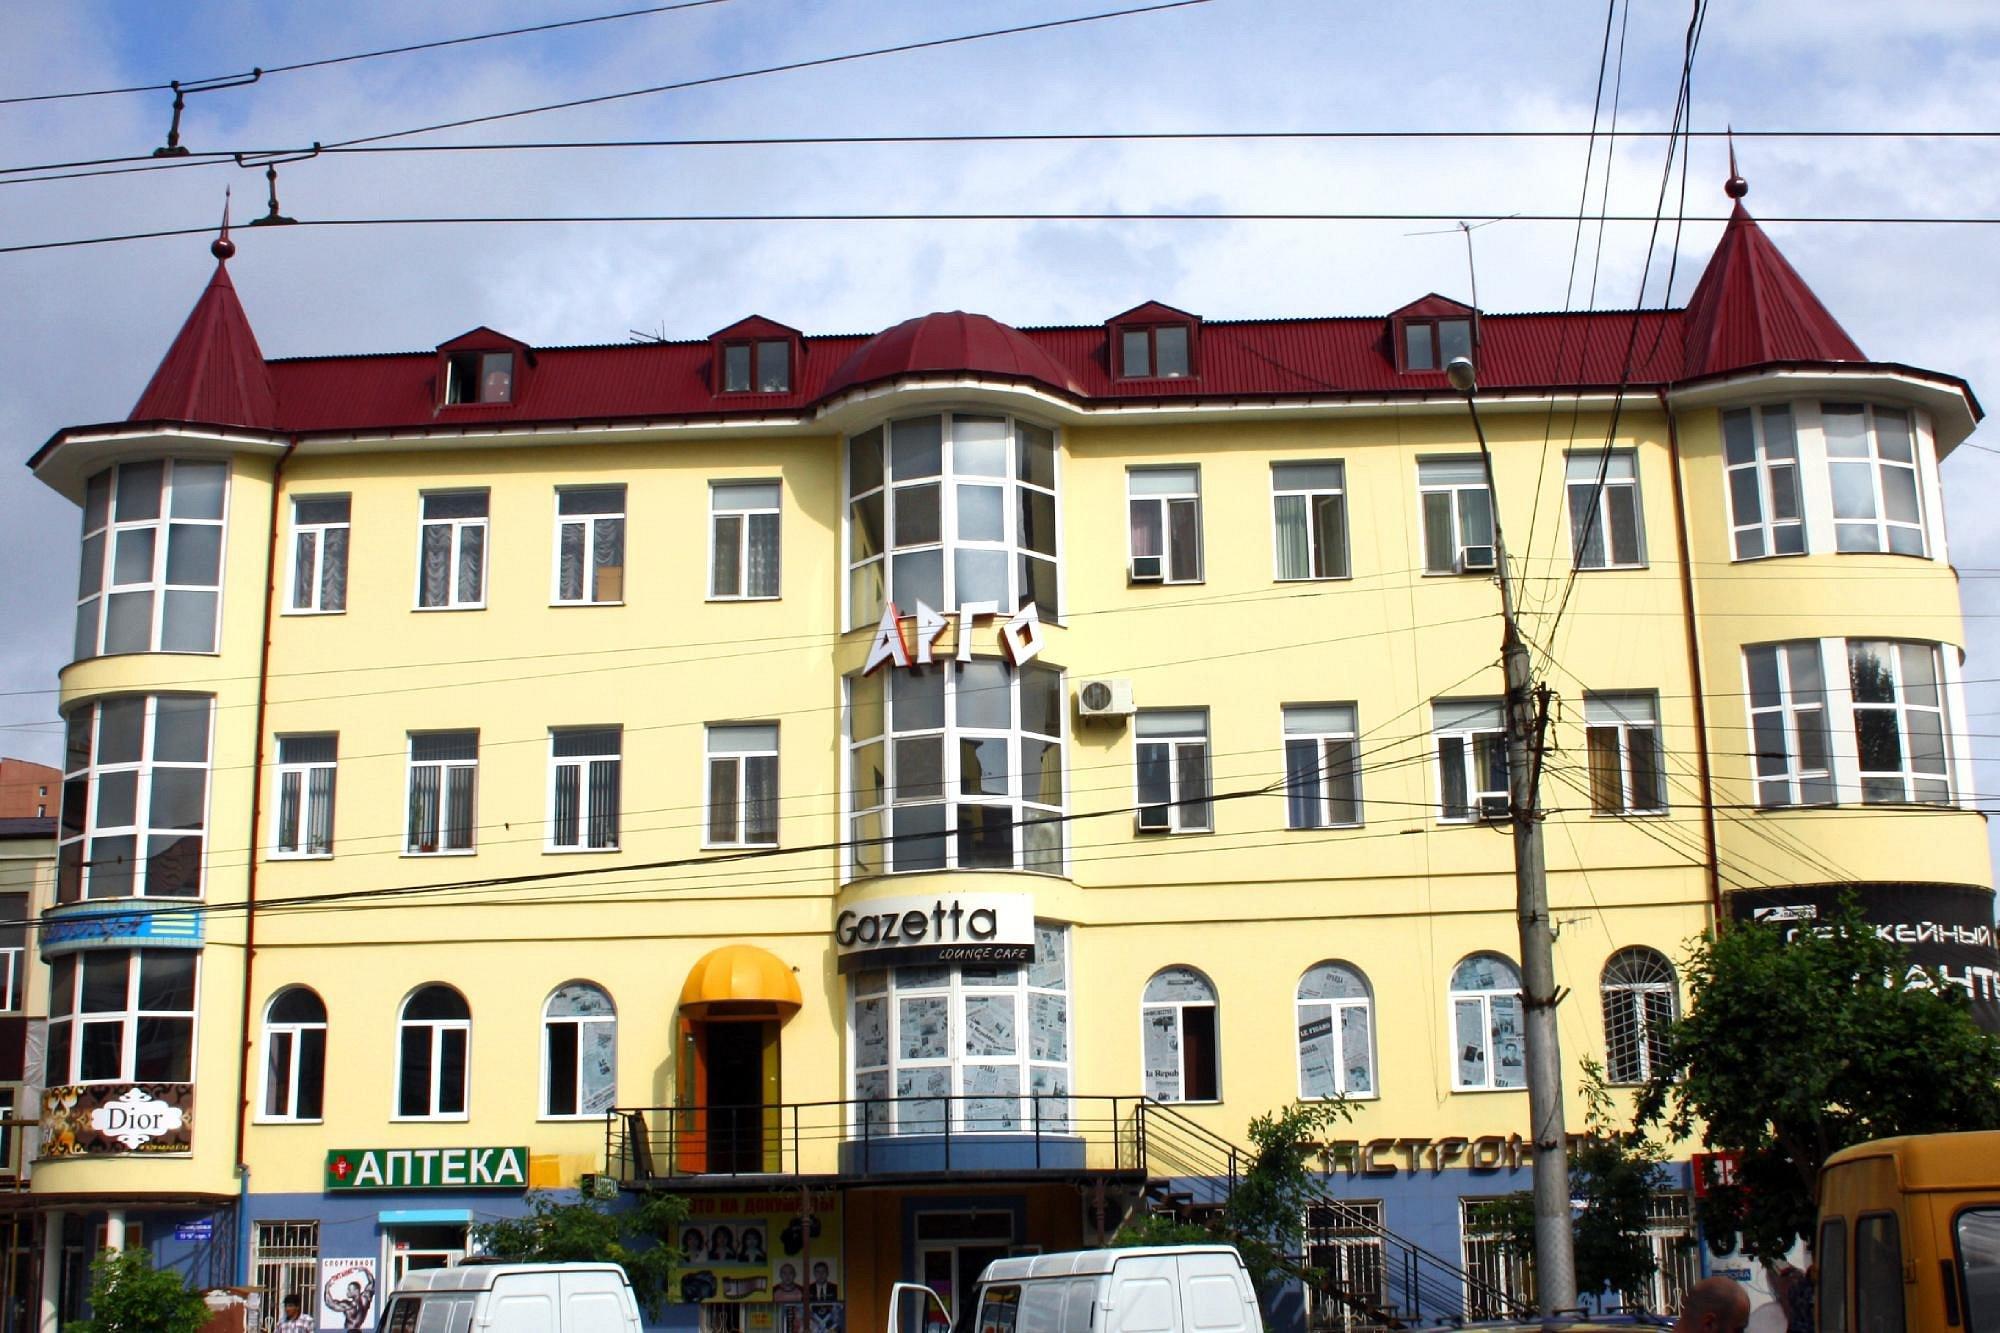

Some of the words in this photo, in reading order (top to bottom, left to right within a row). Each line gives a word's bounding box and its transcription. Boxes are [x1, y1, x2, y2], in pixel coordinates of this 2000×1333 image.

[862, 600, 1046, 677] АРГО
[836, 900, 998, 946] Gazetta
[1787, 921, 1991, 947] ЖЕЙНЫЙ
[938, 948, 992, 961] LOUNGE
[994, 948, 1028, 959] CAFE
[108, 1107, 164, 1130] Dior
[353, 1148, 524, 1186] АПТЕКА
[744, 1196, 836, 1215] ДОКУМЕТЫ
[324, 1259, 374, 1268] СПОРТИВНОЕ
